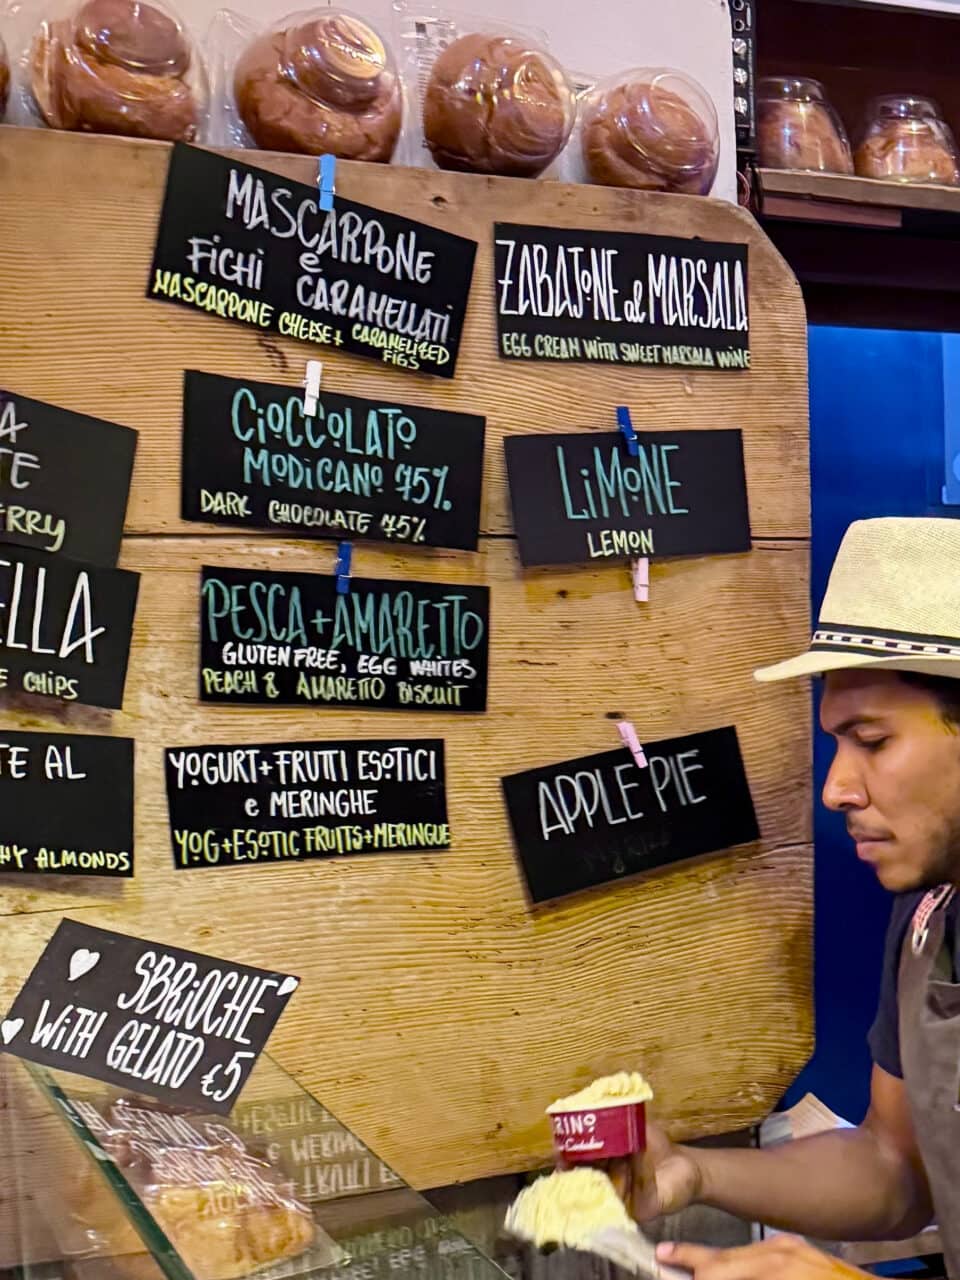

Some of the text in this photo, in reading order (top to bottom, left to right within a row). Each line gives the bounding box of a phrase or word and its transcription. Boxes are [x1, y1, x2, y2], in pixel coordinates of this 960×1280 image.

[225, 168, 435, 284] MASCARPONE
[299, 252, 324, 274] e
[152, 268, 275, 328] MASCARPONE
[647, 252, 749, 332] MARSALA
[502, 332, 532, 358] EGG
[533, 334, 582, 359] CREAM
[619, 342, 662, 364] SWEET
[662, 345, 715, 367] MARSALA
[395, 464, 453, 512] 75%
[200, 488, 427, 544] DARK CHOCOLATE 75%
[586, 528, 656, 559] LEMON
[221, 641, 292, 668] GLUTEN
[356, 655, 398, 676] EGG
[202, 667, 258, 697] PEACH
[261, 671, 280, 699] &
[295, 675, 386, 702] AMARETTO
[44, 744, 87, 780] AL
[356, 746, 437, 782] ESOTICI
[244, 788, 379, 819] e MERINGHE
[537, 748, 709, 842] APPLE PIE
[33, 846, 131, 872] ALMONDS
[106, 1018, 205, 1090] GELATO
